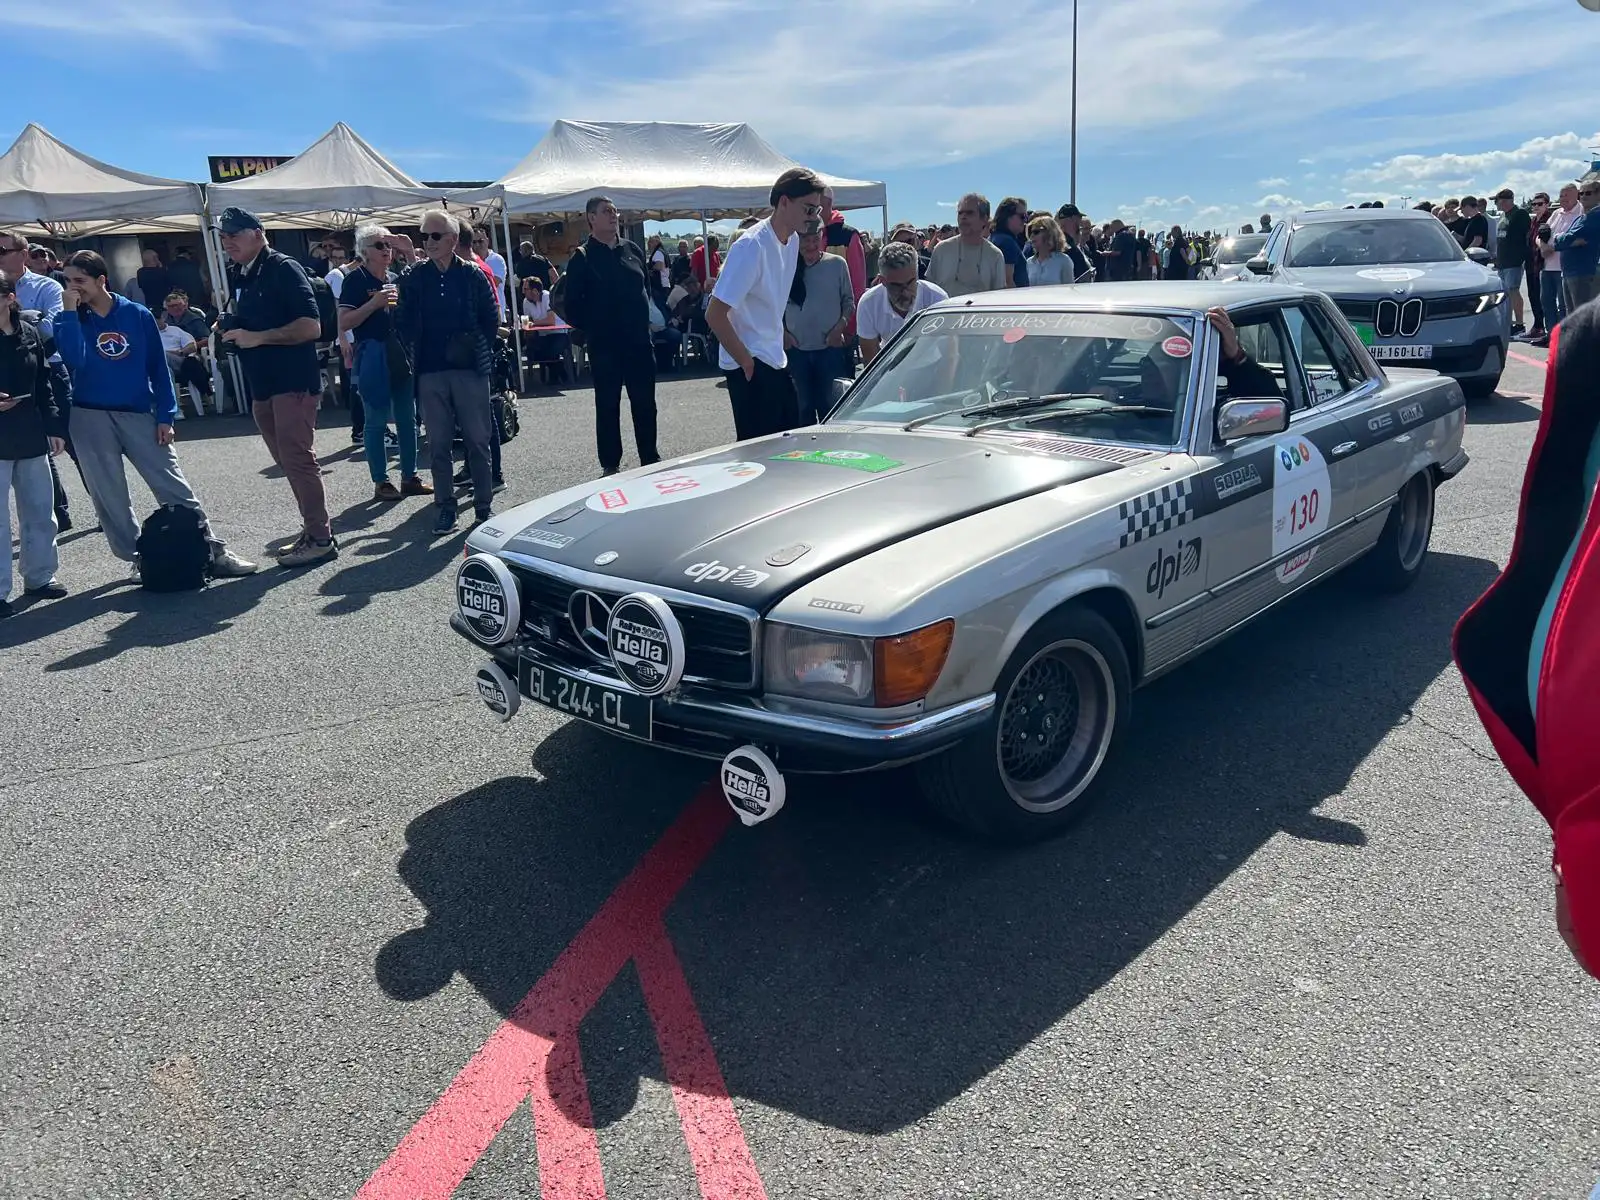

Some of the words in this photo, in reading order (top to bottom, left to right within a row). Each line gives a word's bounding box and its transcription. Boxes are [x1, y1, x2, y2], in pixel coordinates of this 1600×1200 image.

[217, 160, 241, 178] LA
[951, 313, 1112, 330] Mercedes-Benz
[1290, 489, 1319, 536] 130
[683, 560, 746, 583] dpi
[1147, 539, 1183, 600] dpi
[464, 589, 500, 614] Hella
[641, 626, 665, 641] 3000
[617, 633, 663, 662] Hella
[479, 683, 504, 702] Hella
[530, 666, 630, 730] GL-244-CL
[727, 771, 768, 801] Hella
